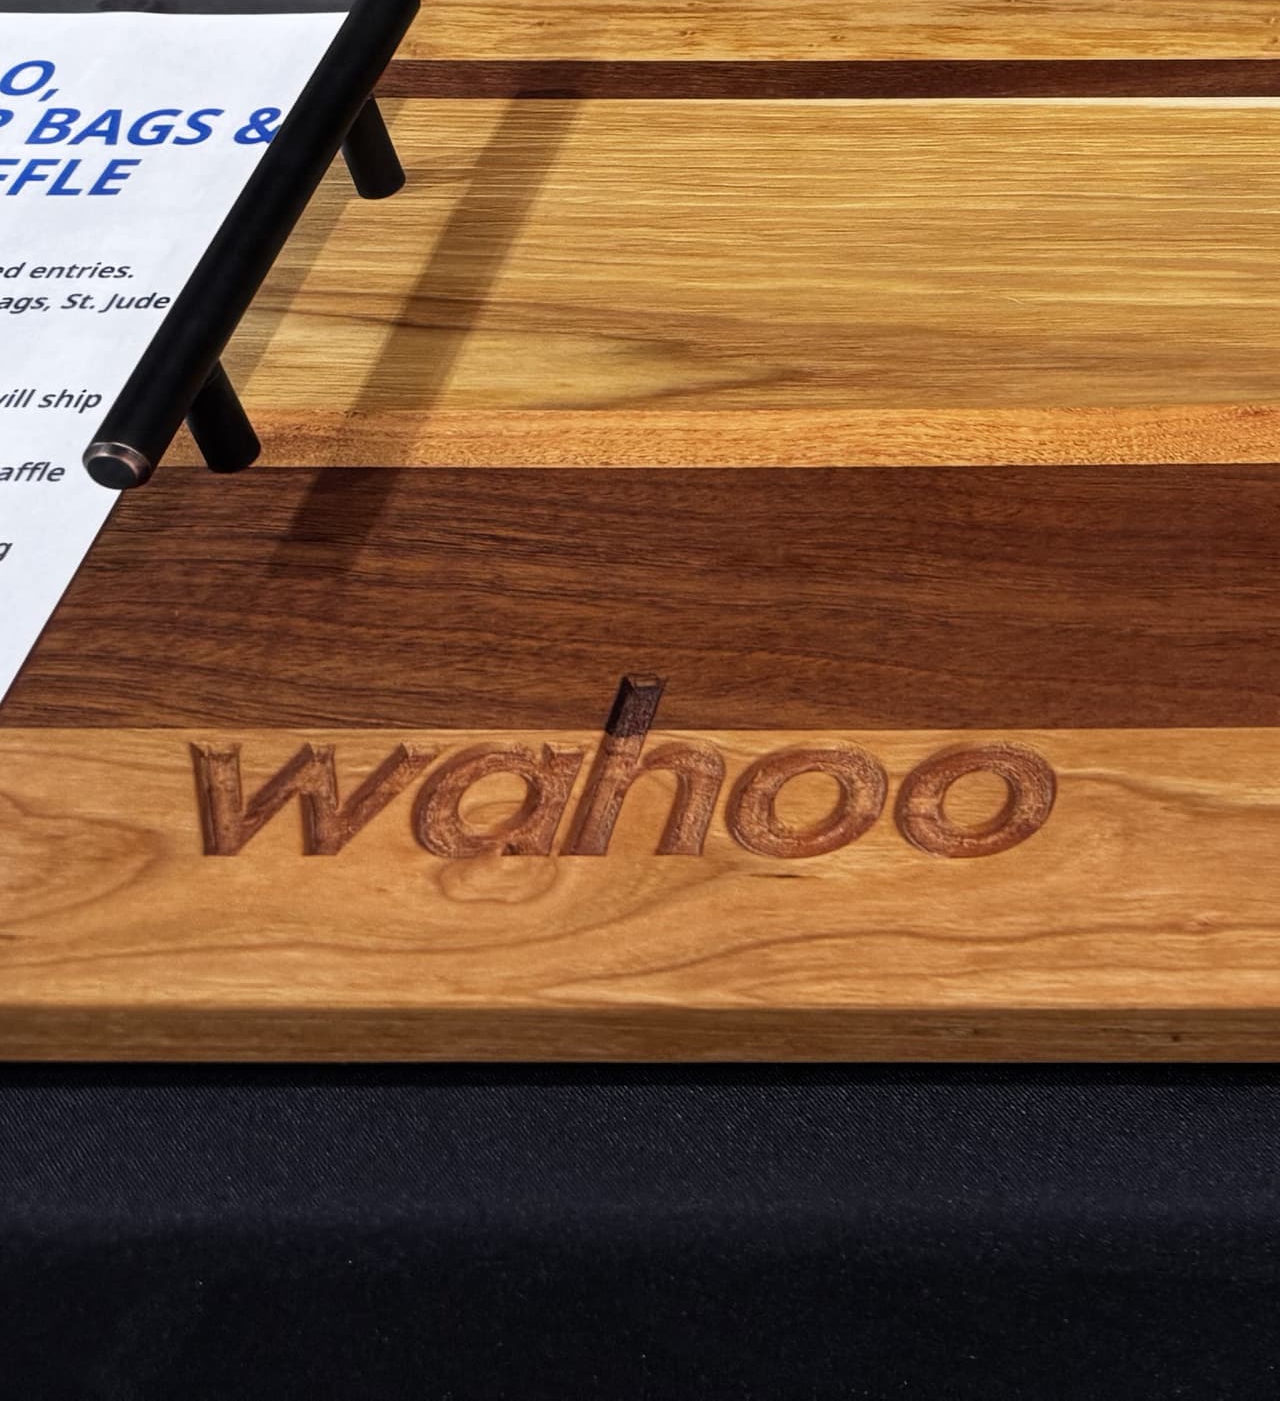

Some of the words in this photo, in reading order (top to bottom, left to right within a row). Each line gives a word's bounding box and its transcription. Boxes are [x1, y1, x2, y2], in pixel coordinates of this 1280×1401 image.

[24, 108, 224, 146] BAGS
[233, 107, 282, 145] &
[29, 263, 134, 279] entries.
[60, 293, 96, 310] St.
[99, 292, 170, 313] Jude
[0, 389, 36, 408] ill
[38, 389, 102, 414] ship
[189, 673, 1058, 859] wahoo
